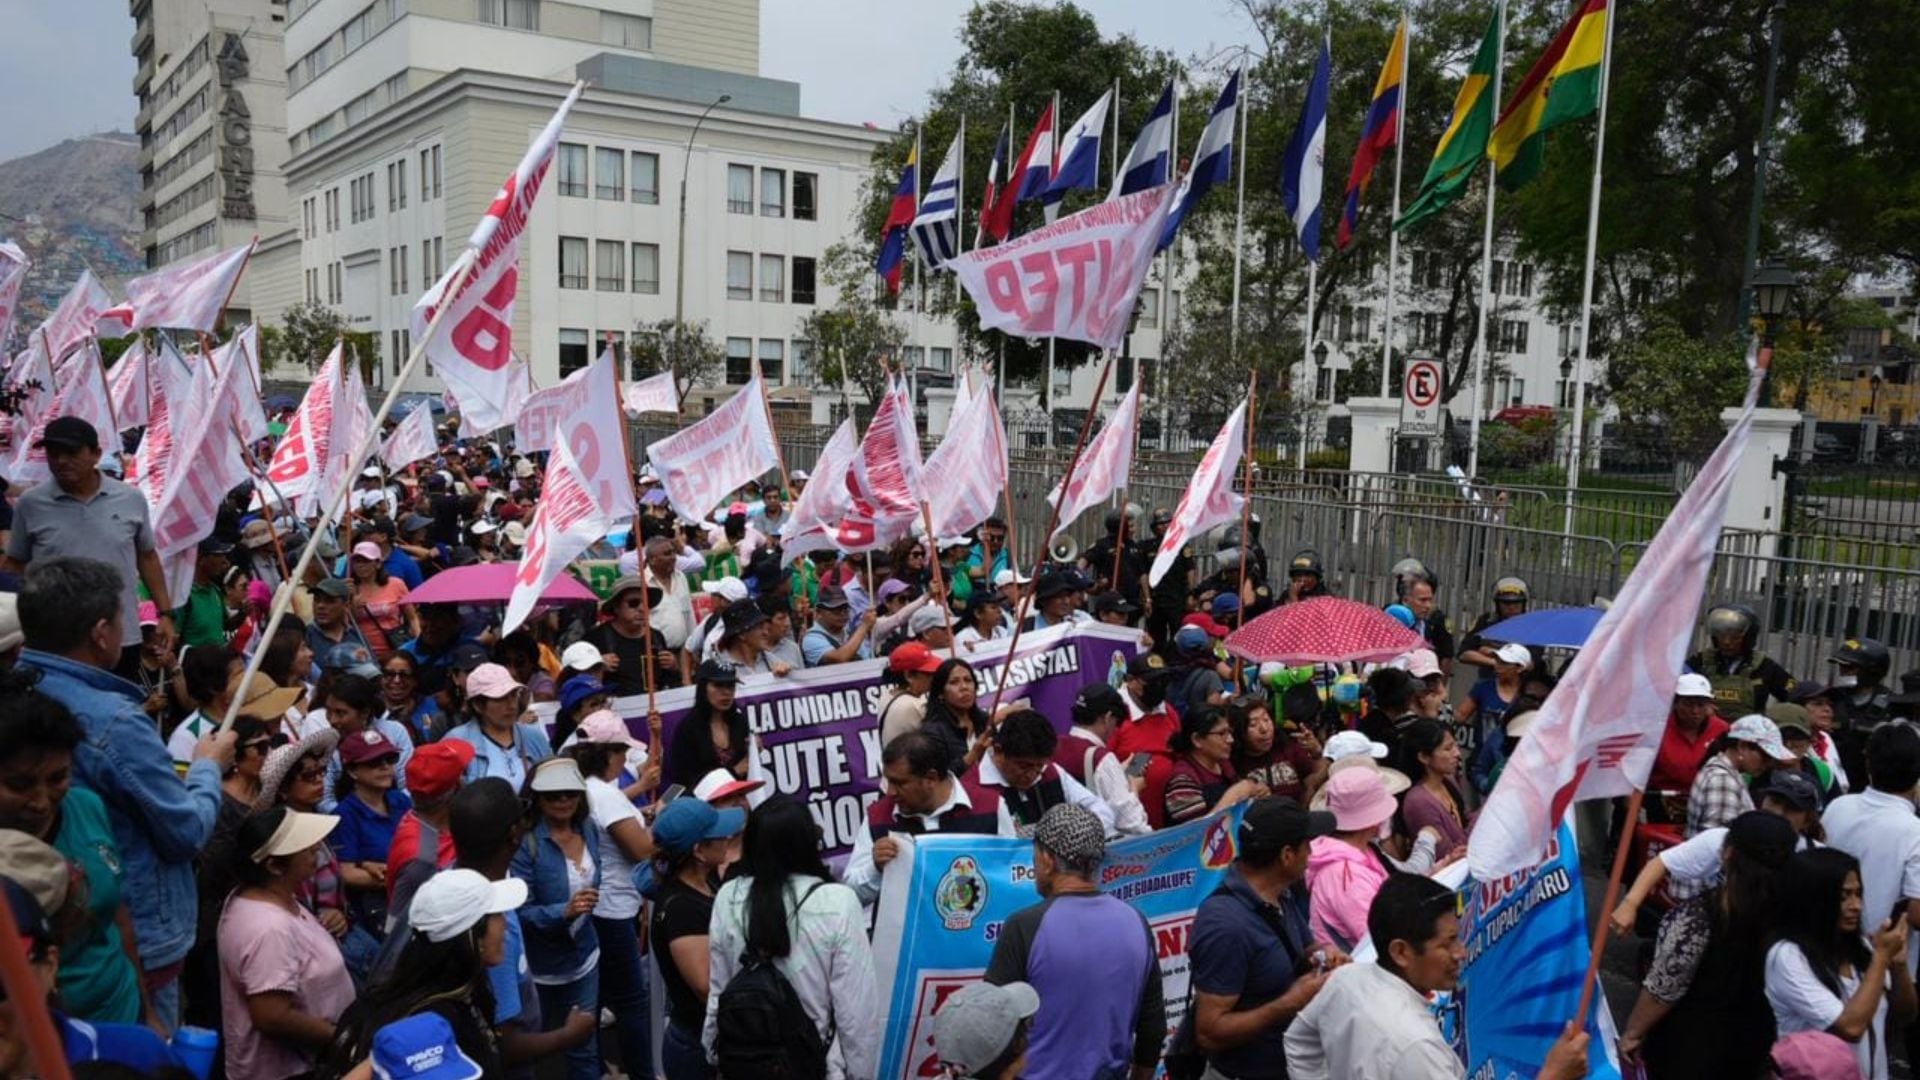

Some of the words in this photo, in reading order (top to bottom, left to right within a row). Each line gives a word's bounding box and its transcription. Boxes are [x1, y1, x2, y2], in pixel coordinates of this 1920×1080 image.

[217, 32, 255, 200] APACHE
[1416, 409, 1426, 420] NO
[747, 703, 777, 735] LA
[777, 689, 863, 730] UNIDAD
